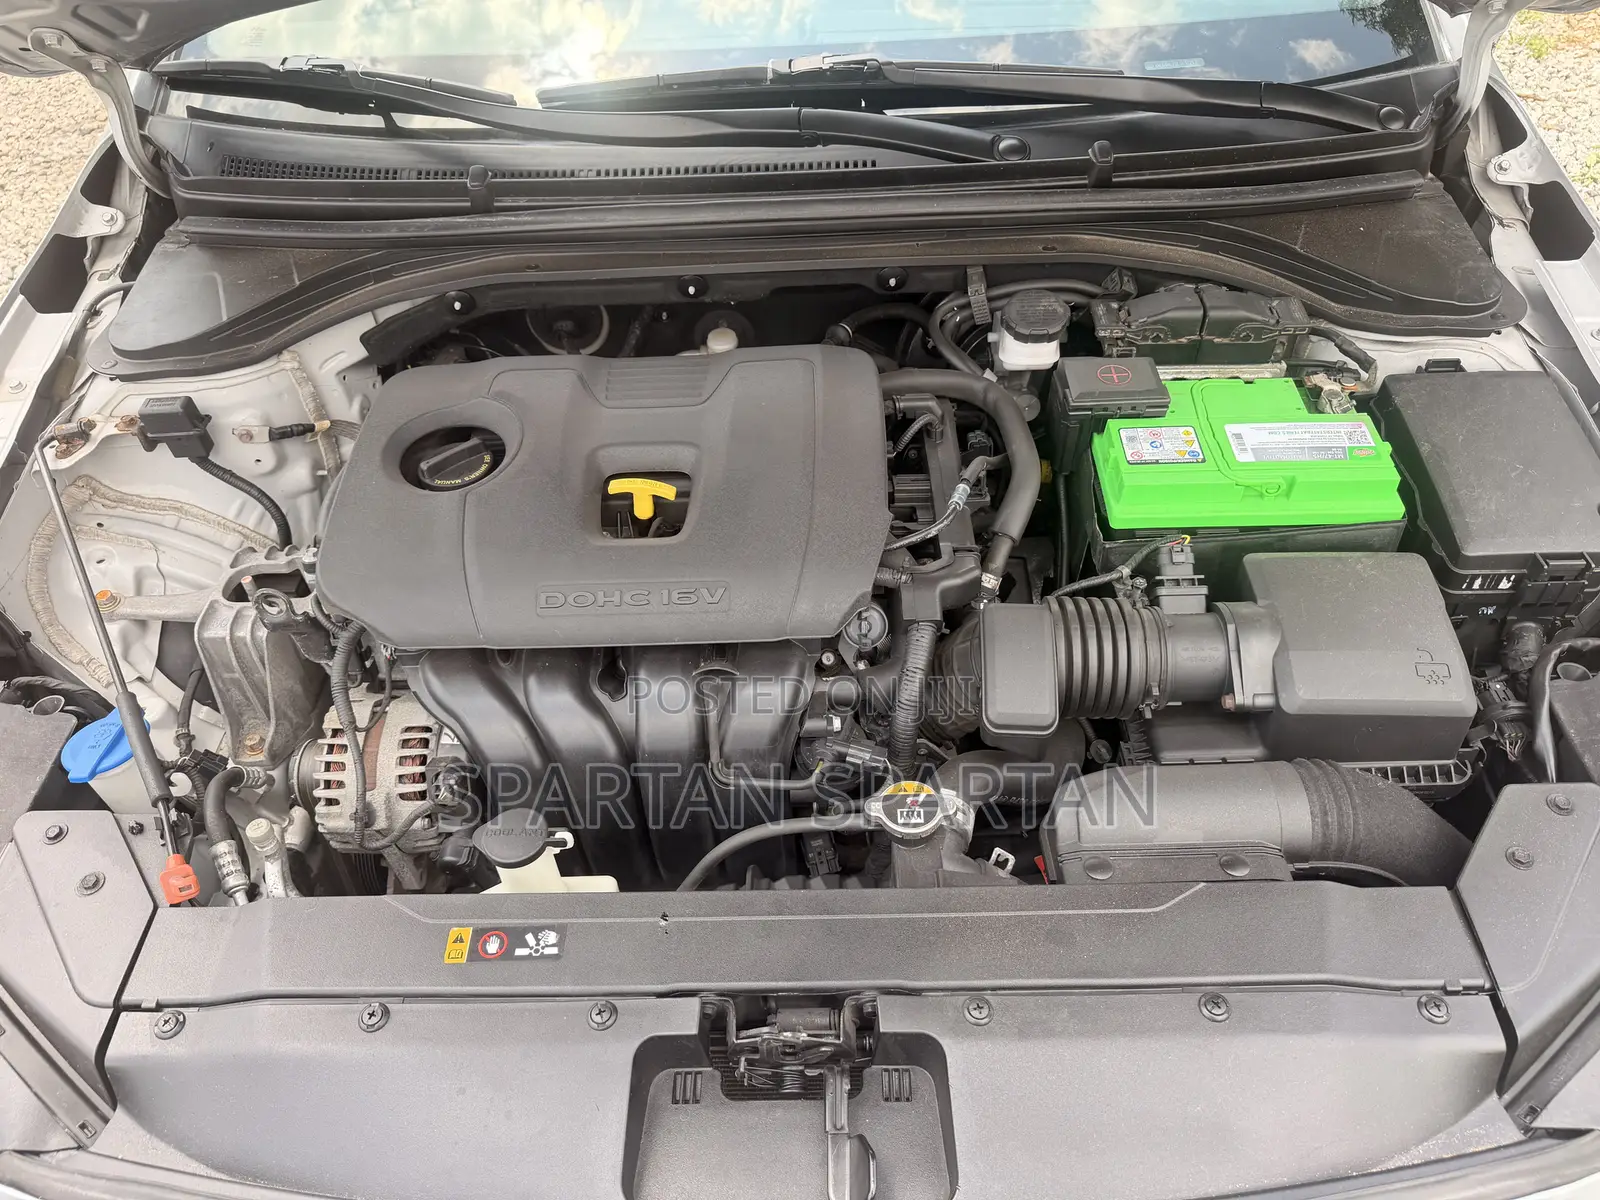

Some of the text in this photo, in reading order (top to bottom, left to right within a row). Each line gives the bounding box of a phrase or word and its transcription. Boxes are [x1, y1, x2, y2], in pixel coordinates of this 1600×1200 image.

[539, 587, 727, 610] DOHC 16V
[485, 828, 544, 838] COOLANT
